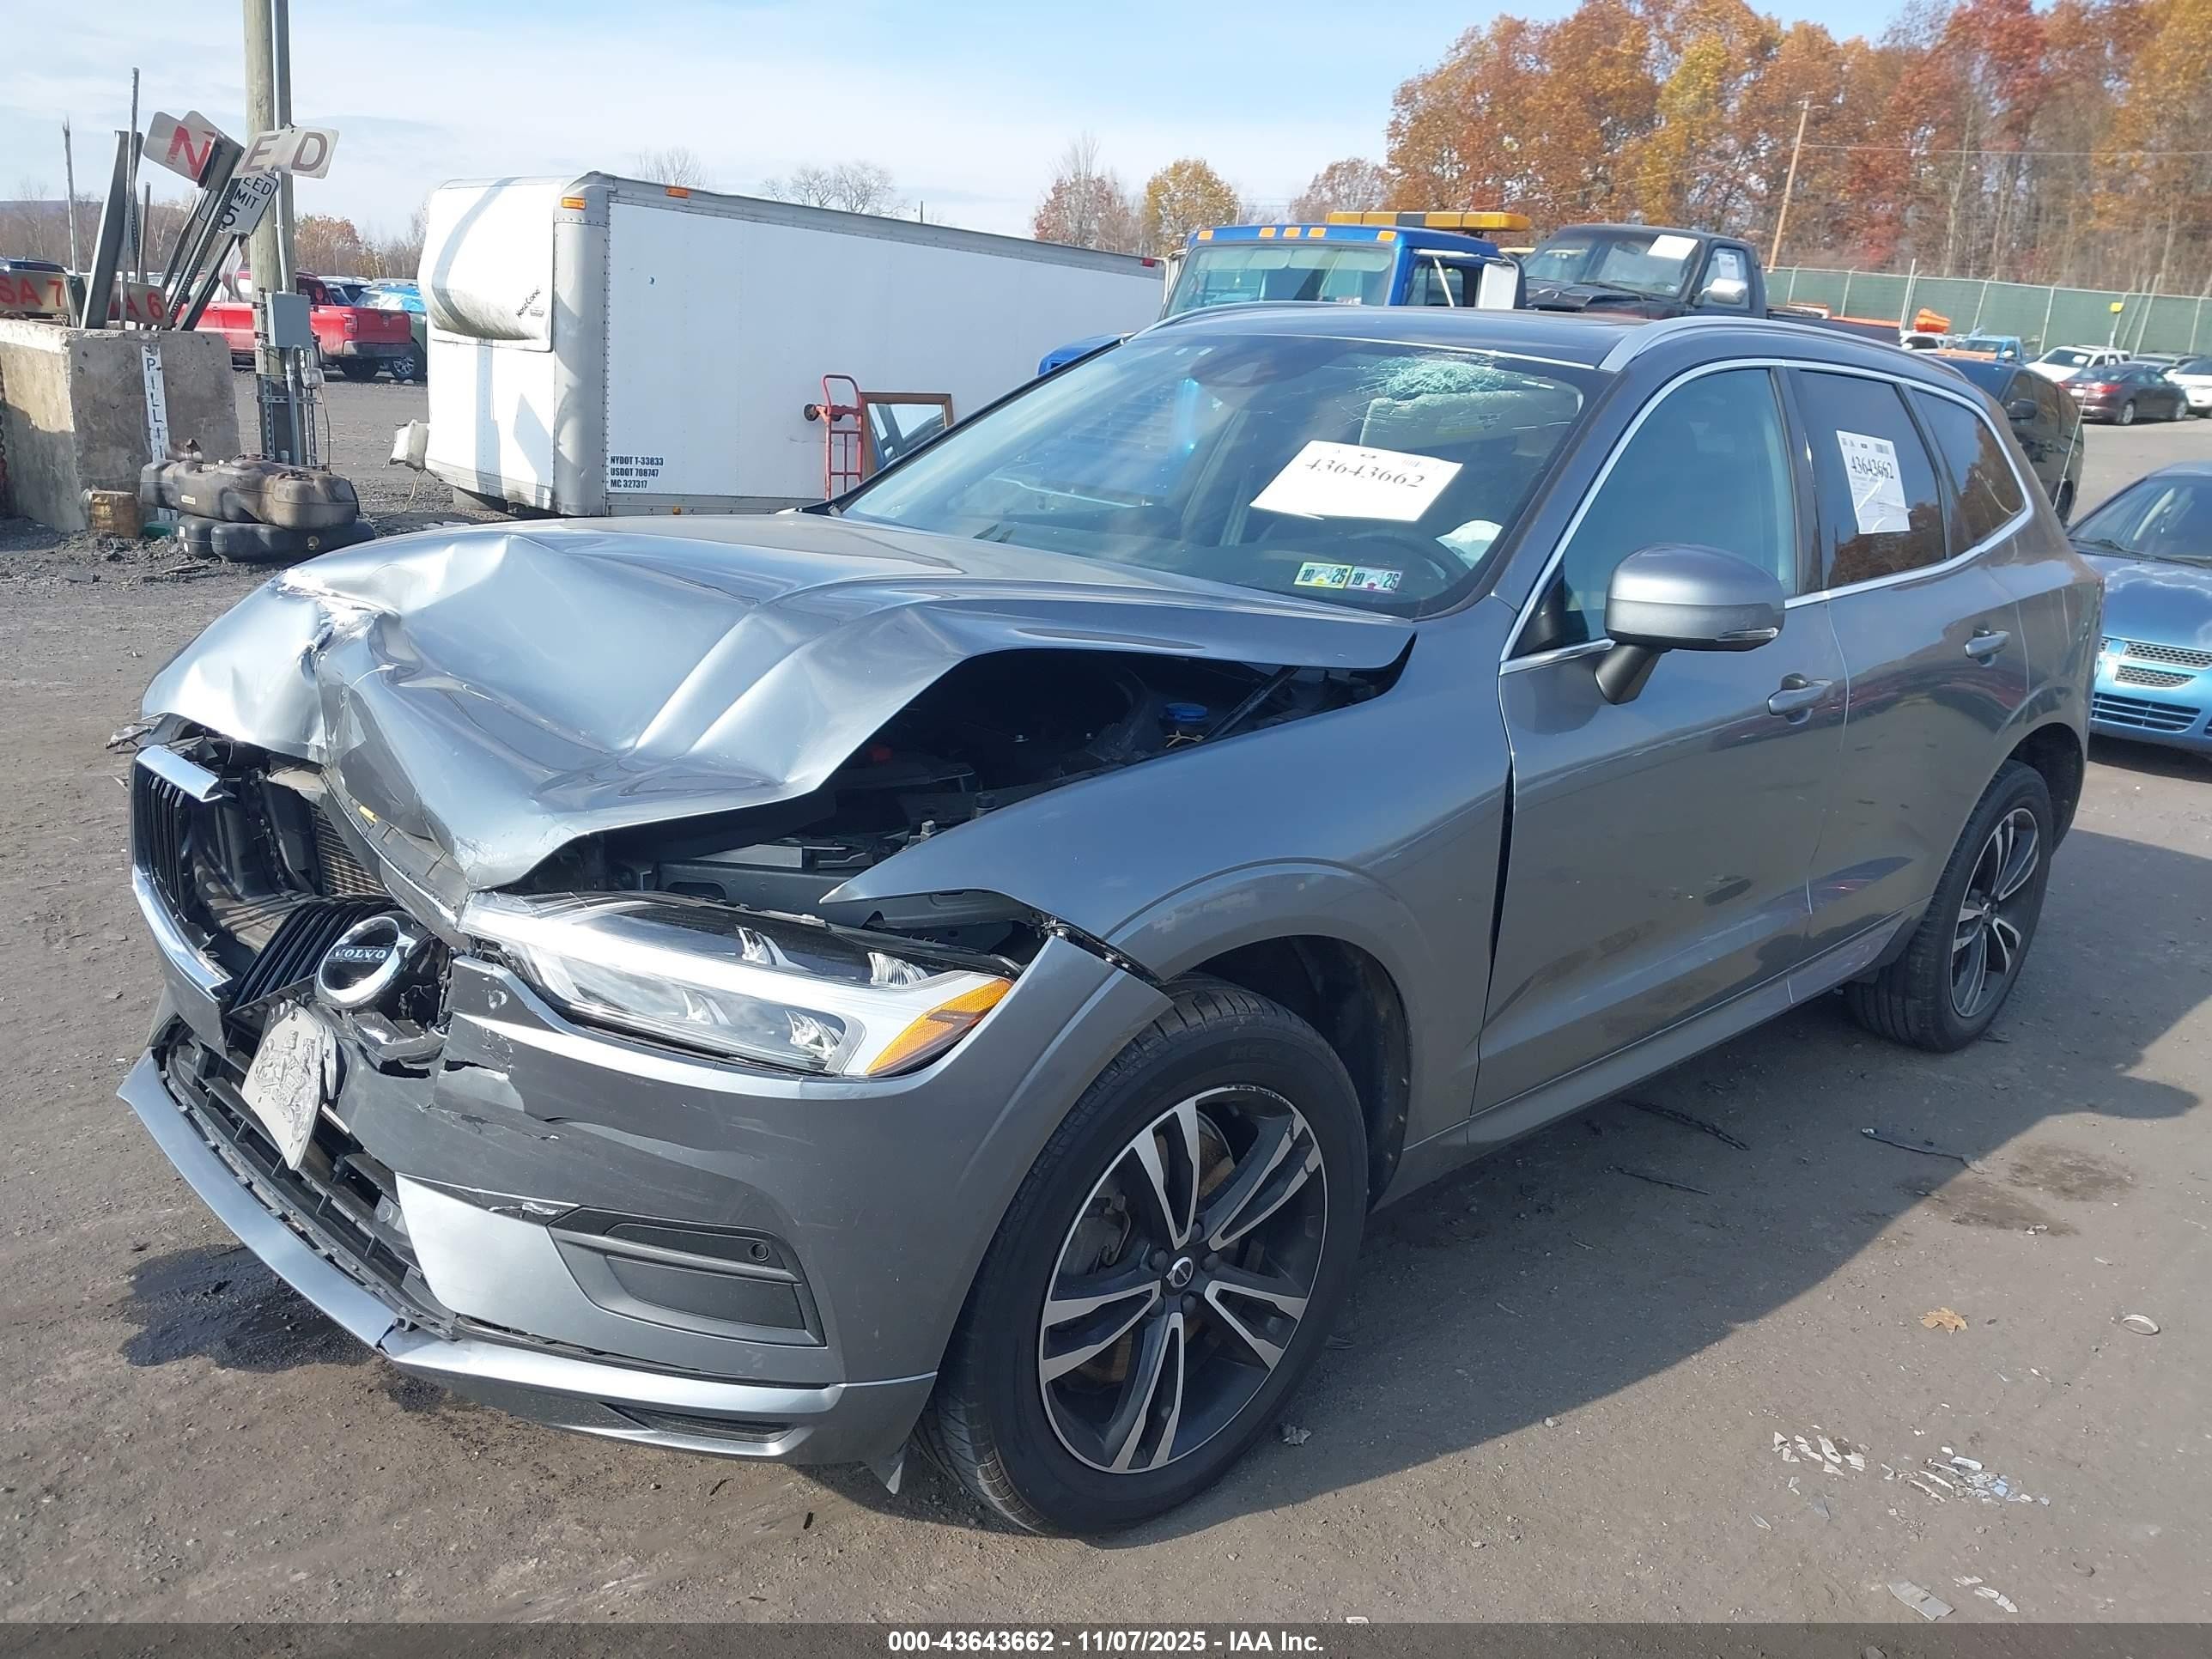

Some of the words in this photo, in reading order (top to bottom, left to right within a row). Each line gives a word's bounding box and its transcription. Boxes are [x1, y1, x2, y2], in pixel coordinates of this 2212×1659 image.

[243, 134, 280, 173] E
[291, 132, 329, 172] D
[243, 177, 272, 196] EED
[234, 188, 260, 210] MIT
[222, 205, 240, 227] 5
[46, 279, 63, 307] 7
[147, 291, 165, 320] 6
[610, 455, 634, 465] NYDOT
[610, 467, 634, 477] USDOT
[1305, 458, 1425, 487] 43643662
[610, 479, 622, 488] MC
[623, 479, 647, 489] 327317
[335, 949, 386, 958] VOLVO
